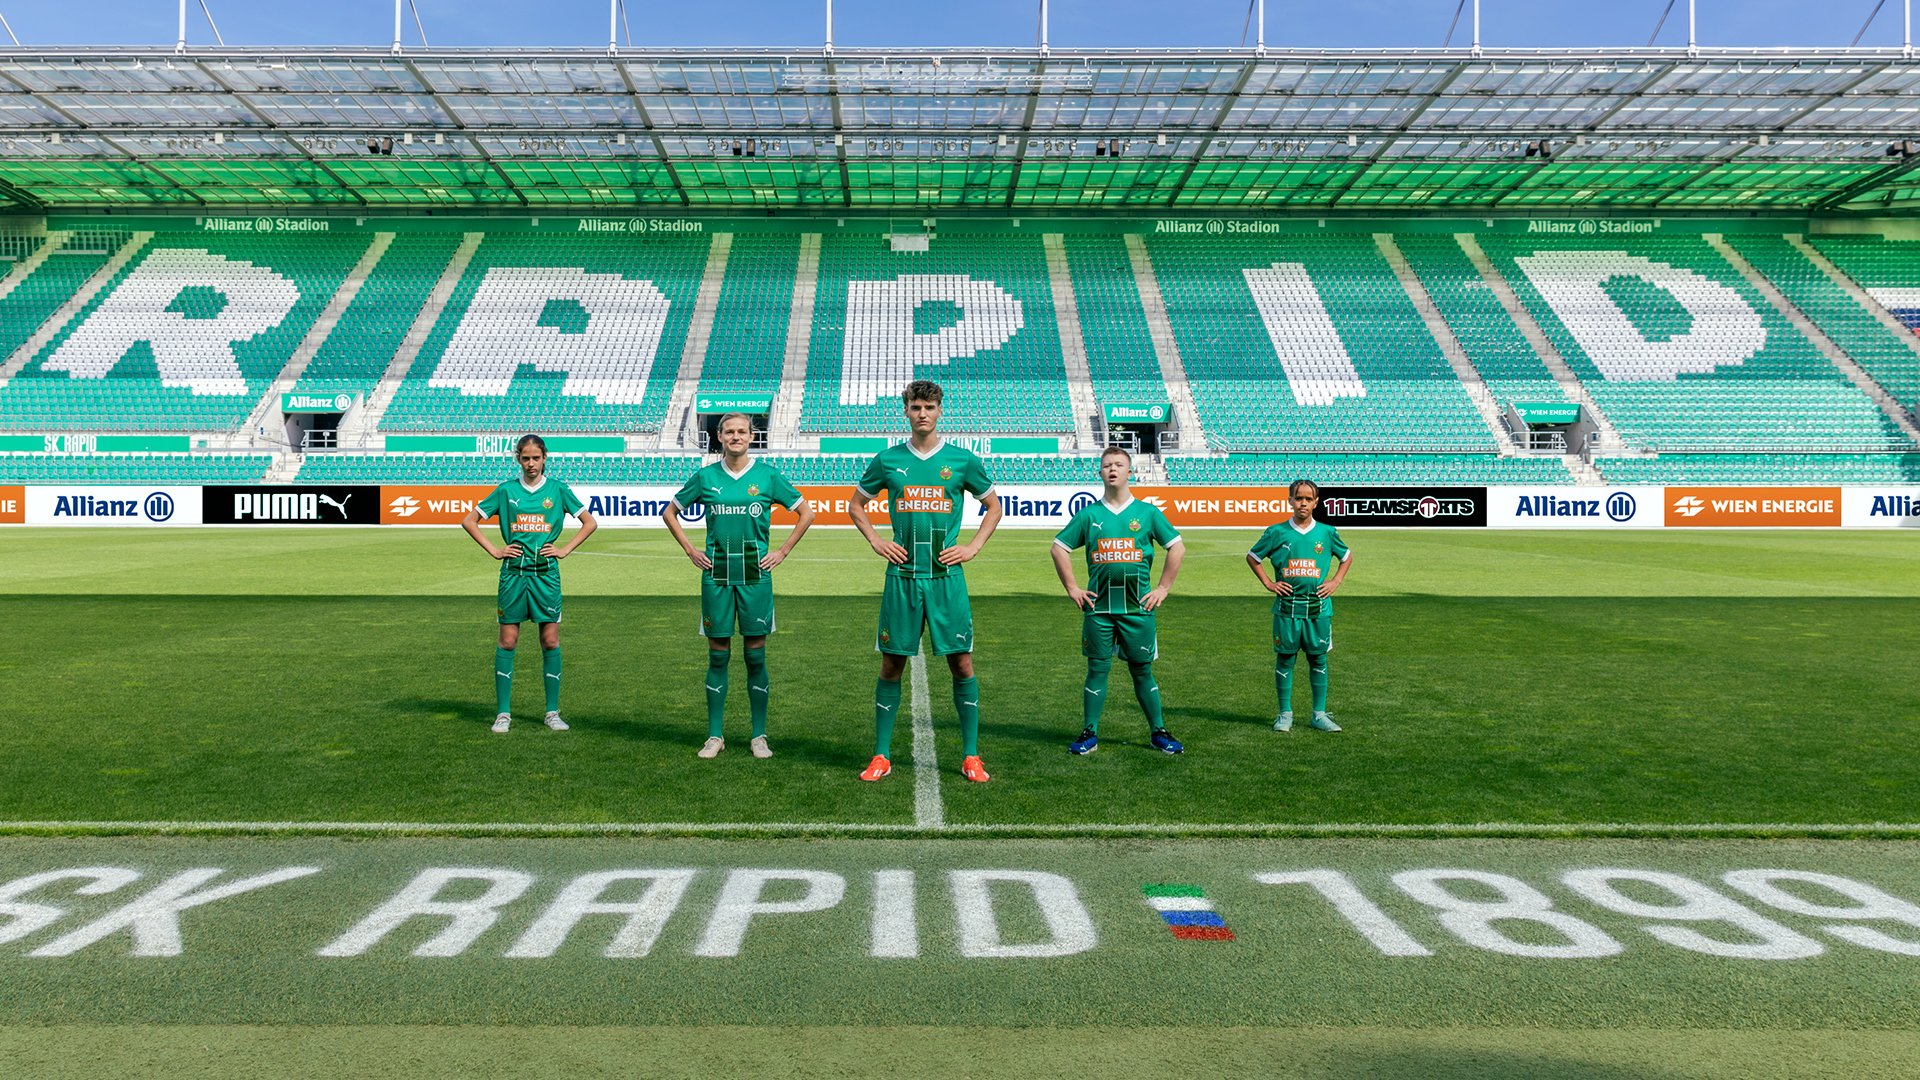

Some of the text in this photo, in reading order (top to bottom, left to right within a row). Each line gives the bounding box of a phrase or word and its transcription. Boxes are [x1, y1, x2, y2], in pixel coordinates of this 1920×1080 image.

[204, 218, 329, 231] Allianz Stadion
[578, 219, 703, 232] Allianz Stadion
[1155, 220, 1280, 233] Allianz Stadion
[1528, 220, 1652, 233] Allianz Stadion
[288, 396, 333, 408] Allianz
[1111, 408, 1148, 417] Allianz
[44, 436, 97, 452] SK RAPID
[476, 436, 520, 453] ACHTZE
[907, 488, 942, 498] WIEN
[54, 496, 138, 516] Allianz
[234, 494, 317, 519] PUMA
[427, 499, 473, 513] WIEN
[588, 496, 670, 516] Allianz
[711, 505, 746, 515] Allianz
[898, 500, 950, 511] ENERGIE
[1174, 500, 1295, 513] WIEN ENERGIE
[1516, 496, 1600, 516] Allianz
[1711, 500, 1834, 513] WIEN ENERGIE
[1870, 496, 1920, 516] Allia
[519, 515, 544, 523] WIEN
[512, 524, 550, 532] ENERGIE
[1101, 540, 1133, 550] WIEN
[1094, 551, 1141, 562] ENERGIE
[1291, 560, 1315, 568] WIEN
[1284, 568, 1319, 576] ENERGIE
[0, 866, 1920, 960] SK RAPID 1899
